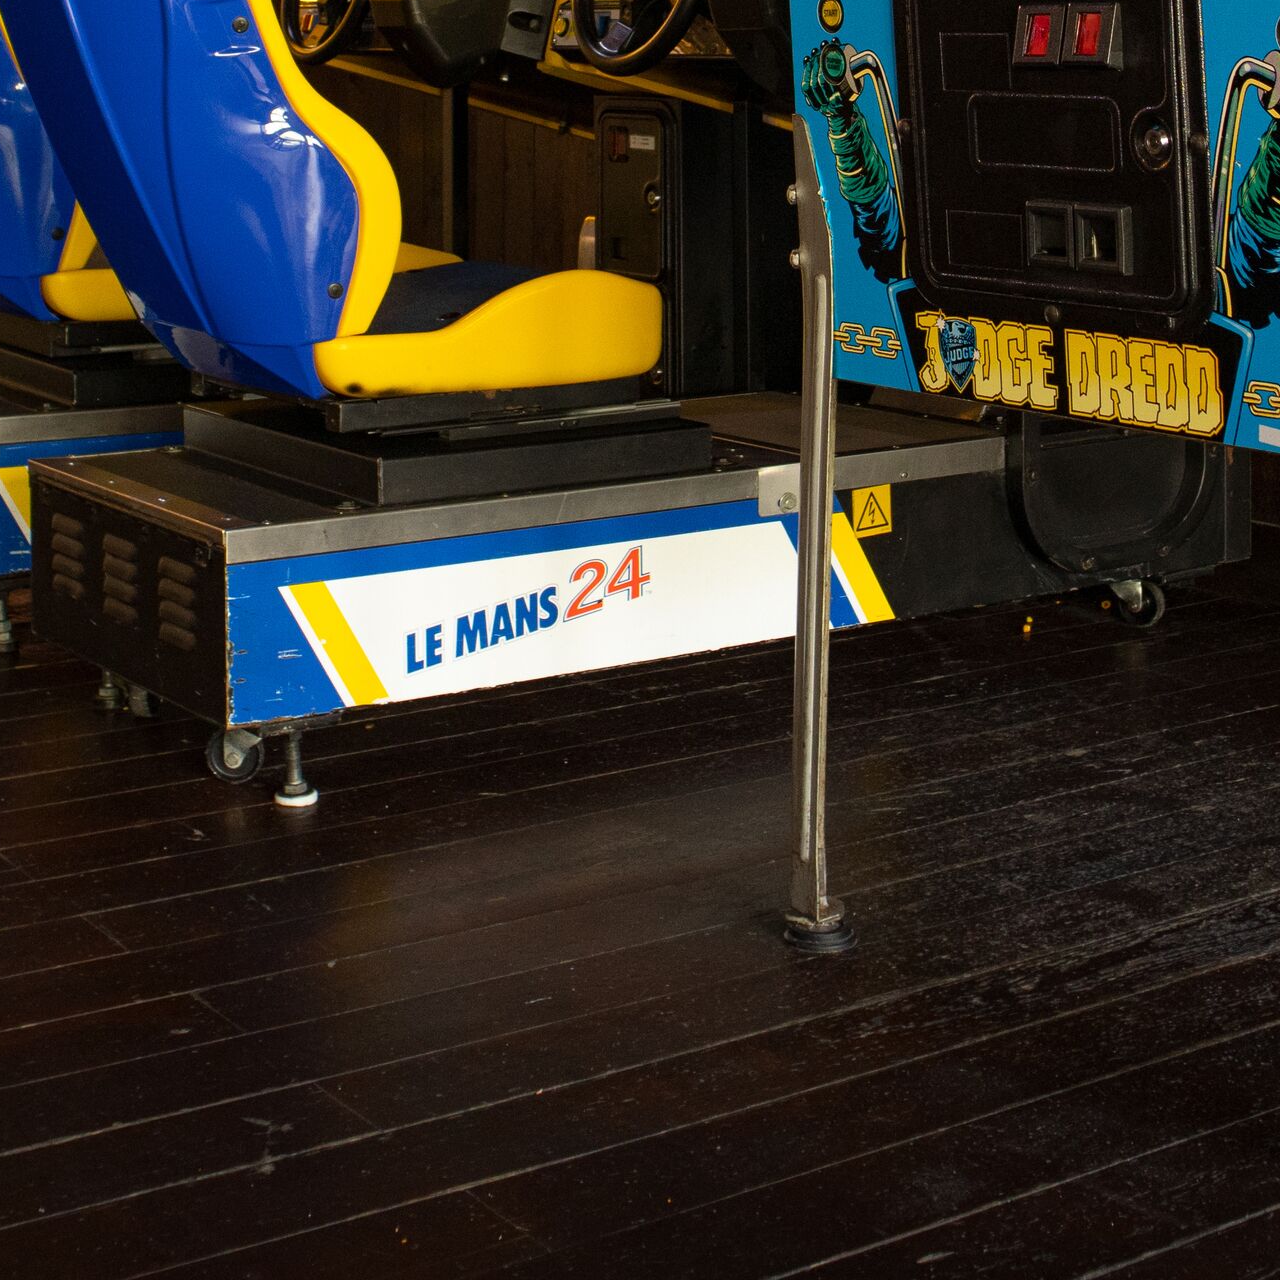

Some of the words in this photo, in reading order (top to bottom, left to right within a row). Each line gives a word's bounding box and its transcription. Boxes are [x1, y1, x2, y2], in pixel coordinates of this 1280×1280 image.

[823, 9, 838, 17] START
[945, 346, 975, 364] JUDGE
[1064, 327, 1227, 437] DREDD
[405, 623, 444, 674] LE
[455, 584, 559, 660] MANS
[563, 545, 652, 622] 24
